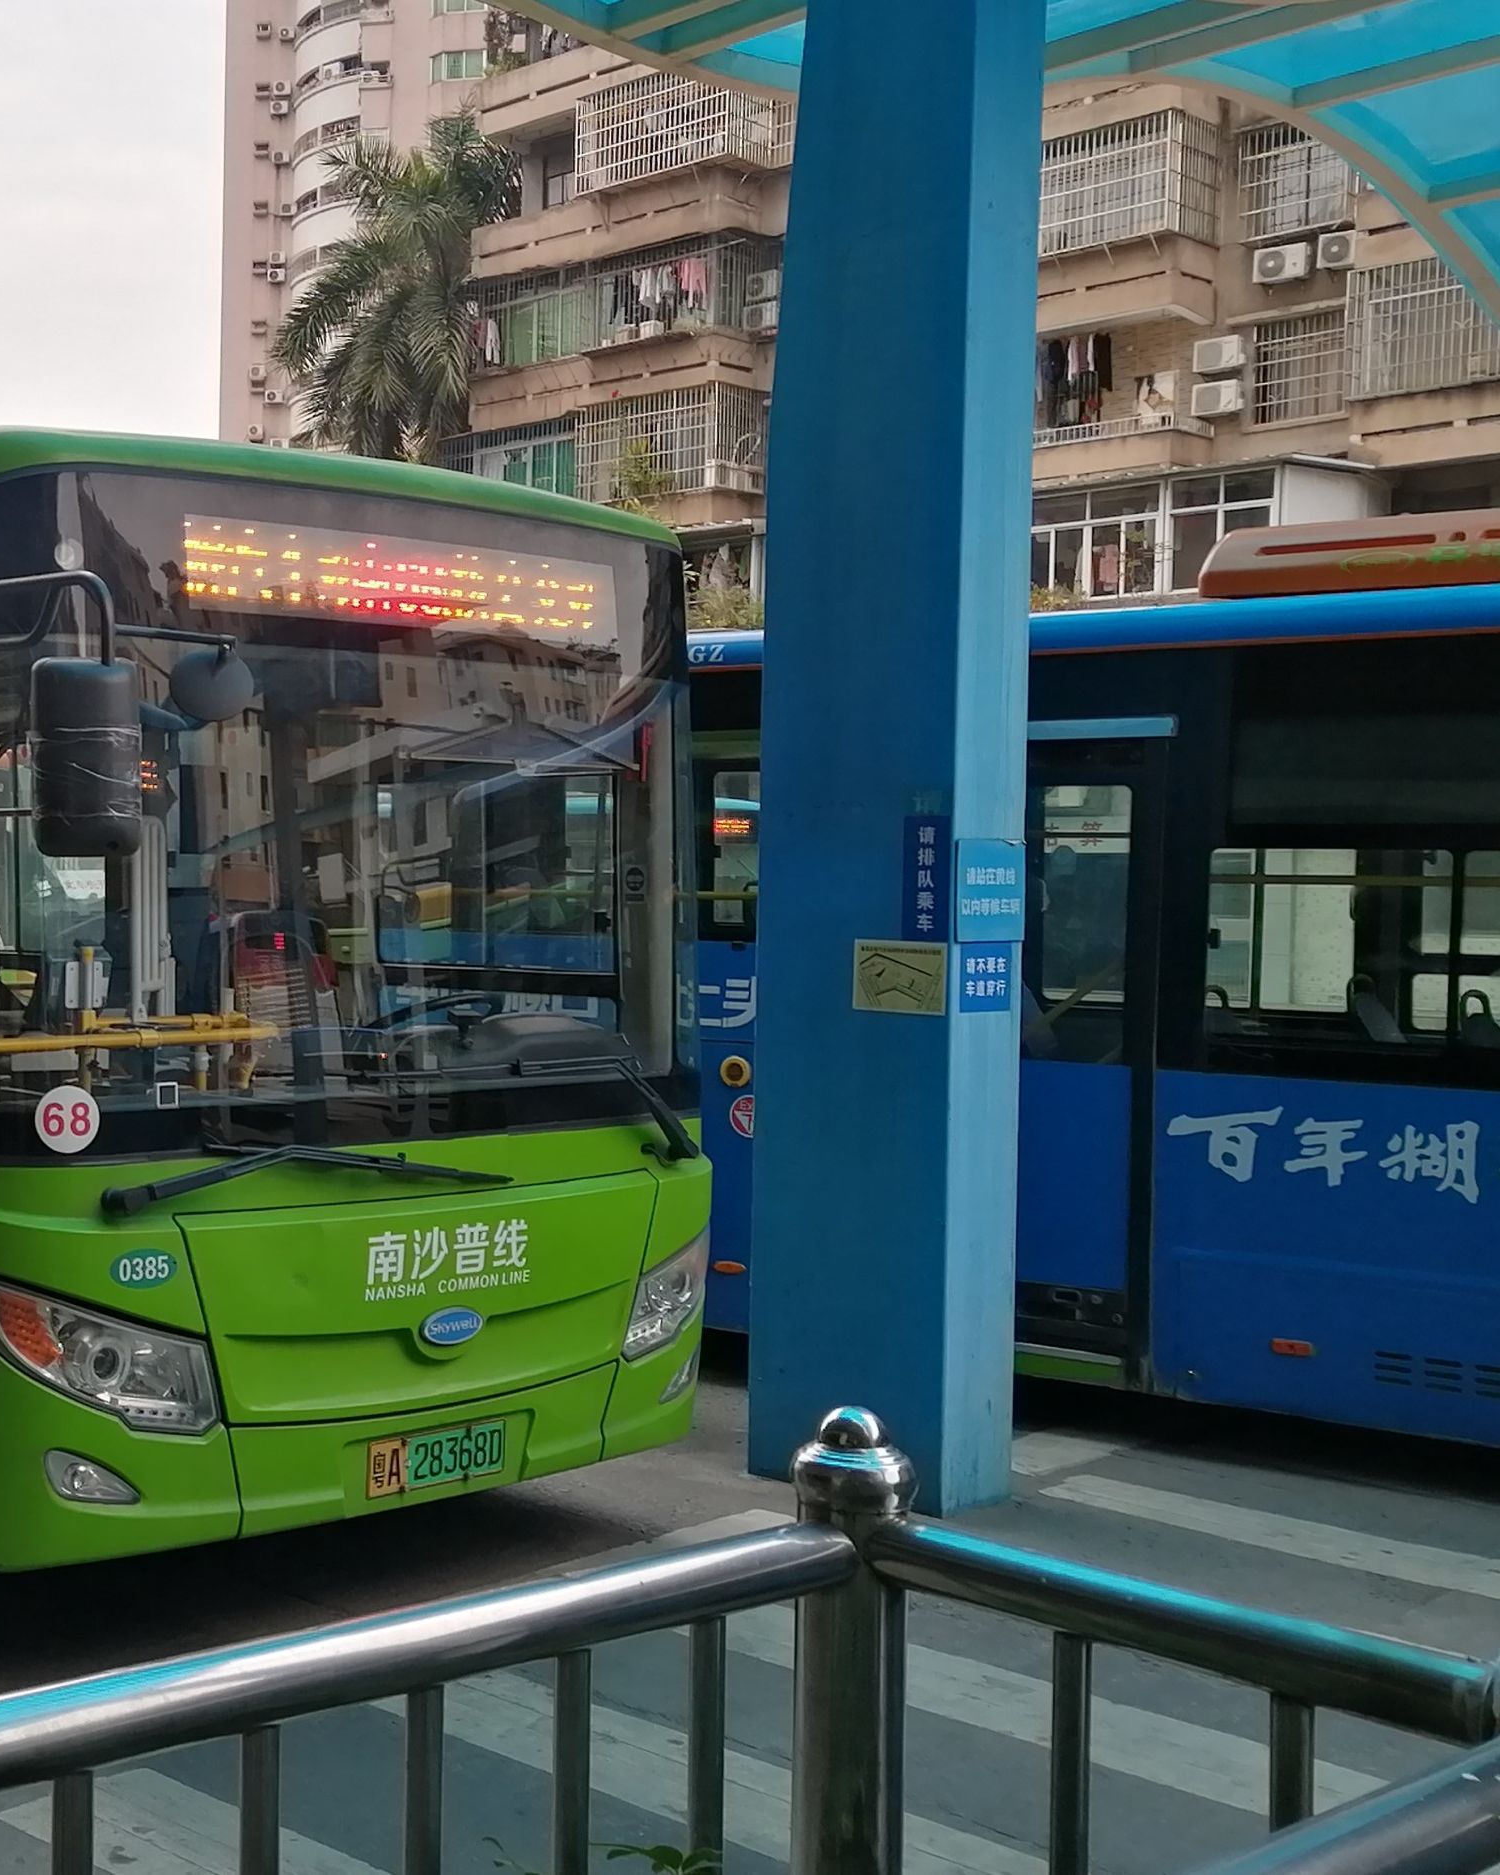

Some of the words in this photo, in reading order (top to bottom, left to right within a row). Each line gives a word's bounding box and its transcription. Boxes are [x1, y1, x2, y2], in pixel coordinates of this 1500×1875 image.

[687, 644, 726, 664] GZ
[916, 825, 936, 933] 请排队乘车
[966, 866, 1016, 886] 请站在黄线
[961, 897, 1022, 916] 以内等候车辆
[965, 955, 1007, 976] 请不要在
[964, 979, 1007, 998] 车道穿行
[42, 1101, 91, 1137] 68
[1166, 1105, 1481, 1204] 百年糊
[366, 1218, 529, 1286] 南沙普线
[118, 1255, 170, 1282] 0385
[364, 1281, 426, 1302] NANSHA
[437, 1274, 499, 1294] COMMON
[501, 1269, 531, 1287] LINE
